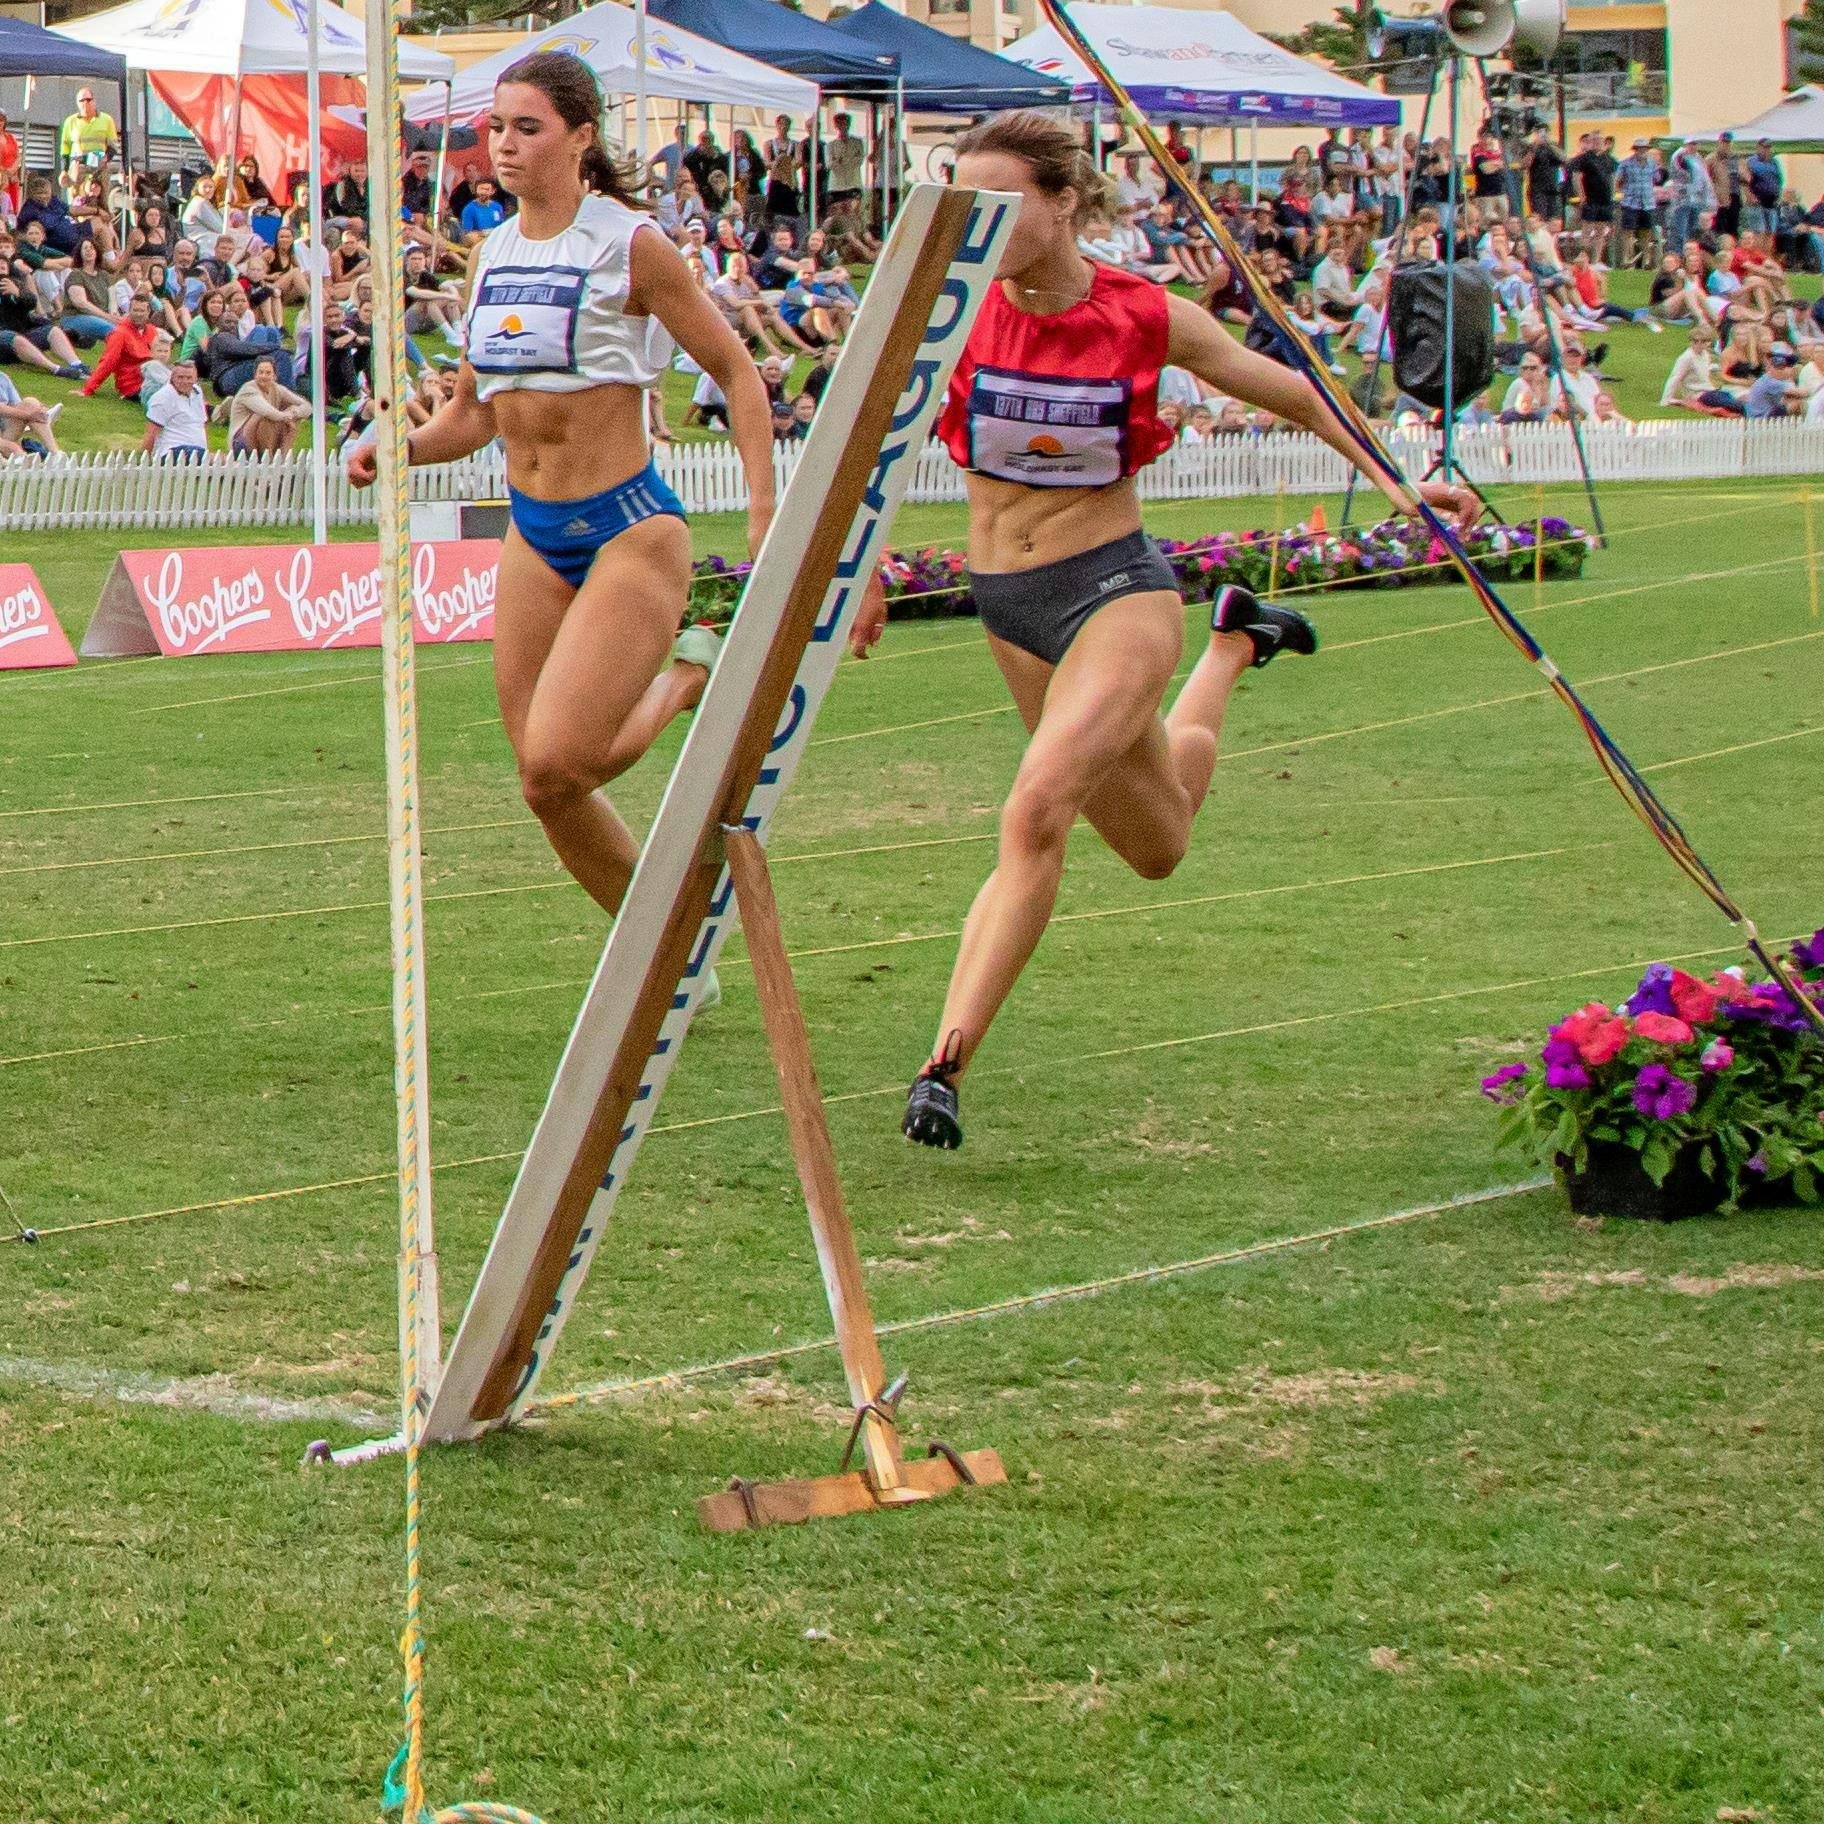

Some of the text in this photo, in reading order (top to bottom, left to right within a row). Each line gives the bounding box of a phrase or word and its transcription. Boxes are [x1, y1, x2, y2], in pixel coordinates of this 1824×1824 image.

[143, 543, 499, 650] Coopers Cooper Cooper
